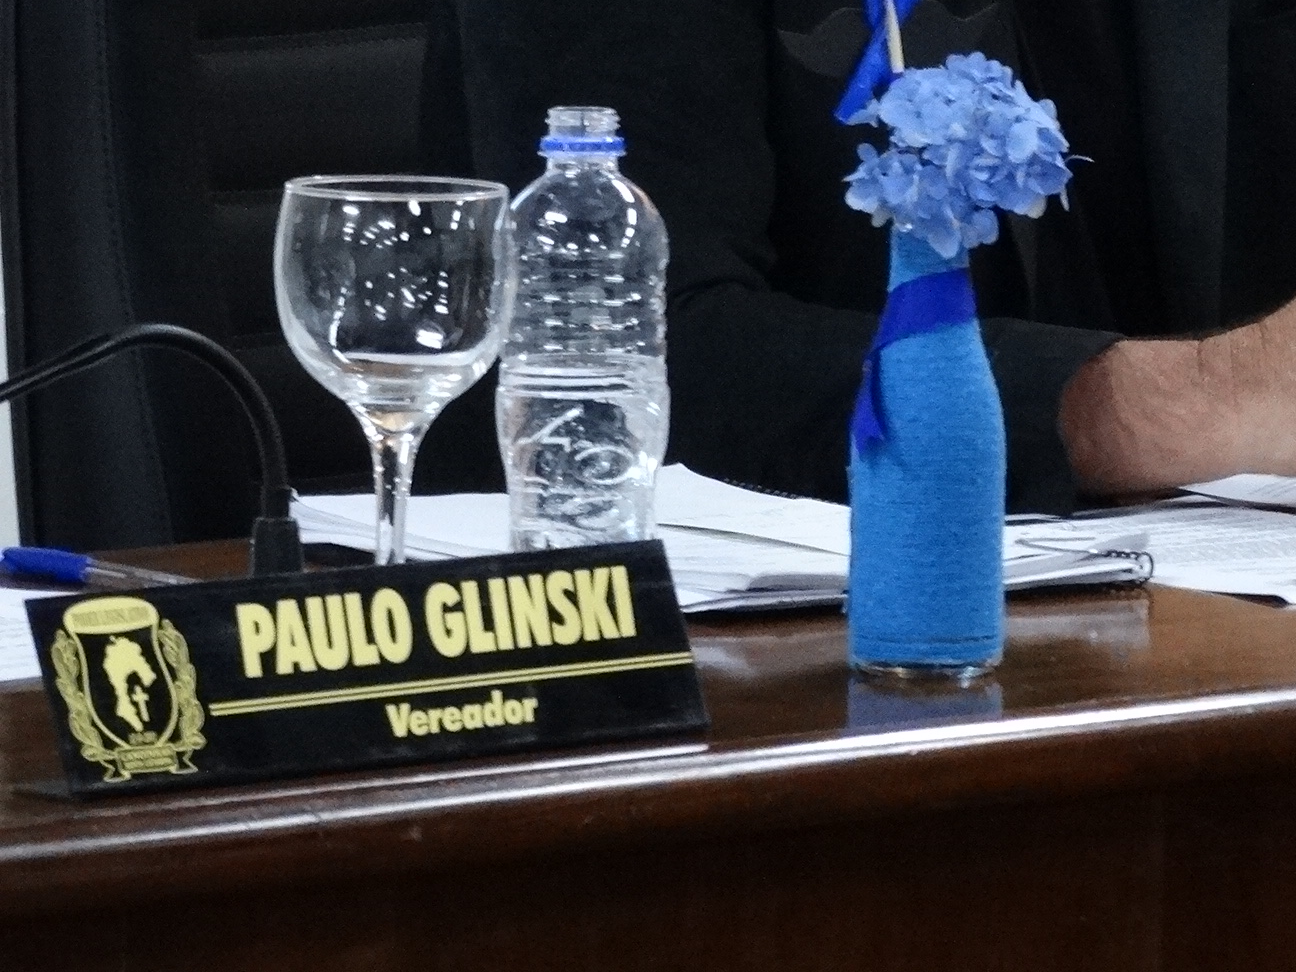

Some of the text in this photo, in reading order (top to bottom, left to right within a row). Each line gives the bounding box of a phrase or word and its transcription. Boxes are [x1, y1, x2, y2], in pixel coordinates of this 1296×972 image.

[236, 564, 637, 679] PAULO GLINSKI
[386, 688, 539, 739] Vereador
